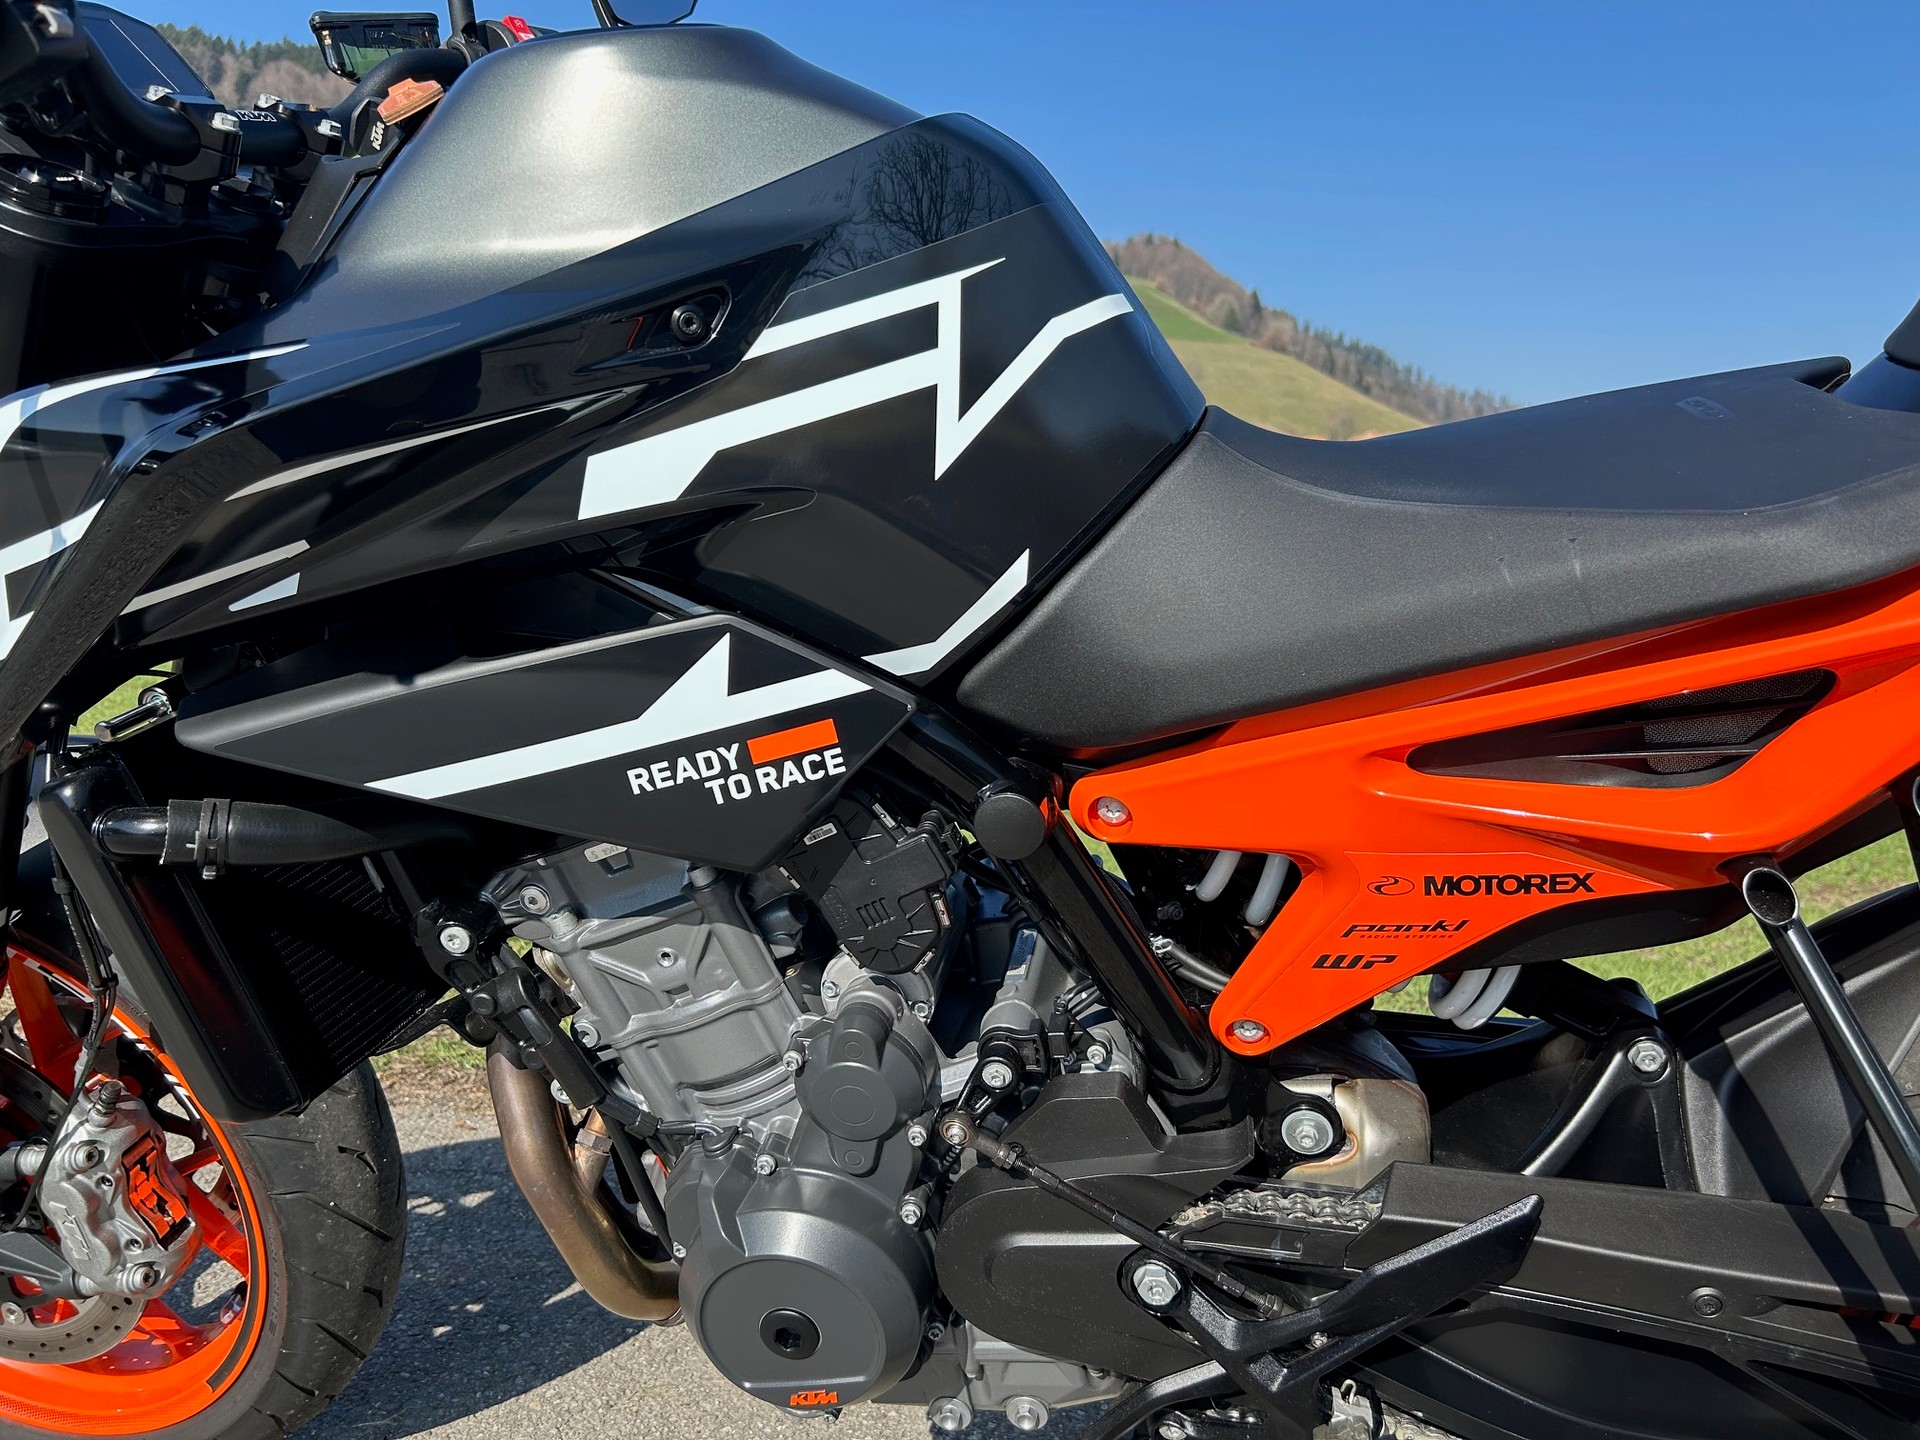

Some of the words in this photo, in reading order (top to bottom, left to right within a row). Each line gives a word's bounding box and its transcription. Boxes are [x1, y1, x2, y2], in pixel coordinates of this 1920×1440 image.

[235, 109, 277, 122] KTM
[371, 120, 386, 150] KTM
[626, 742, 740, 796] READY
[703, 772, 753, 805] TO
[754, 747, 847, 794] RACE
[1424, 872, 1597, 896] MOTOREX
[1311, 954, 1398, 970] WP
[790, 1389, 838, 1406] KTM
